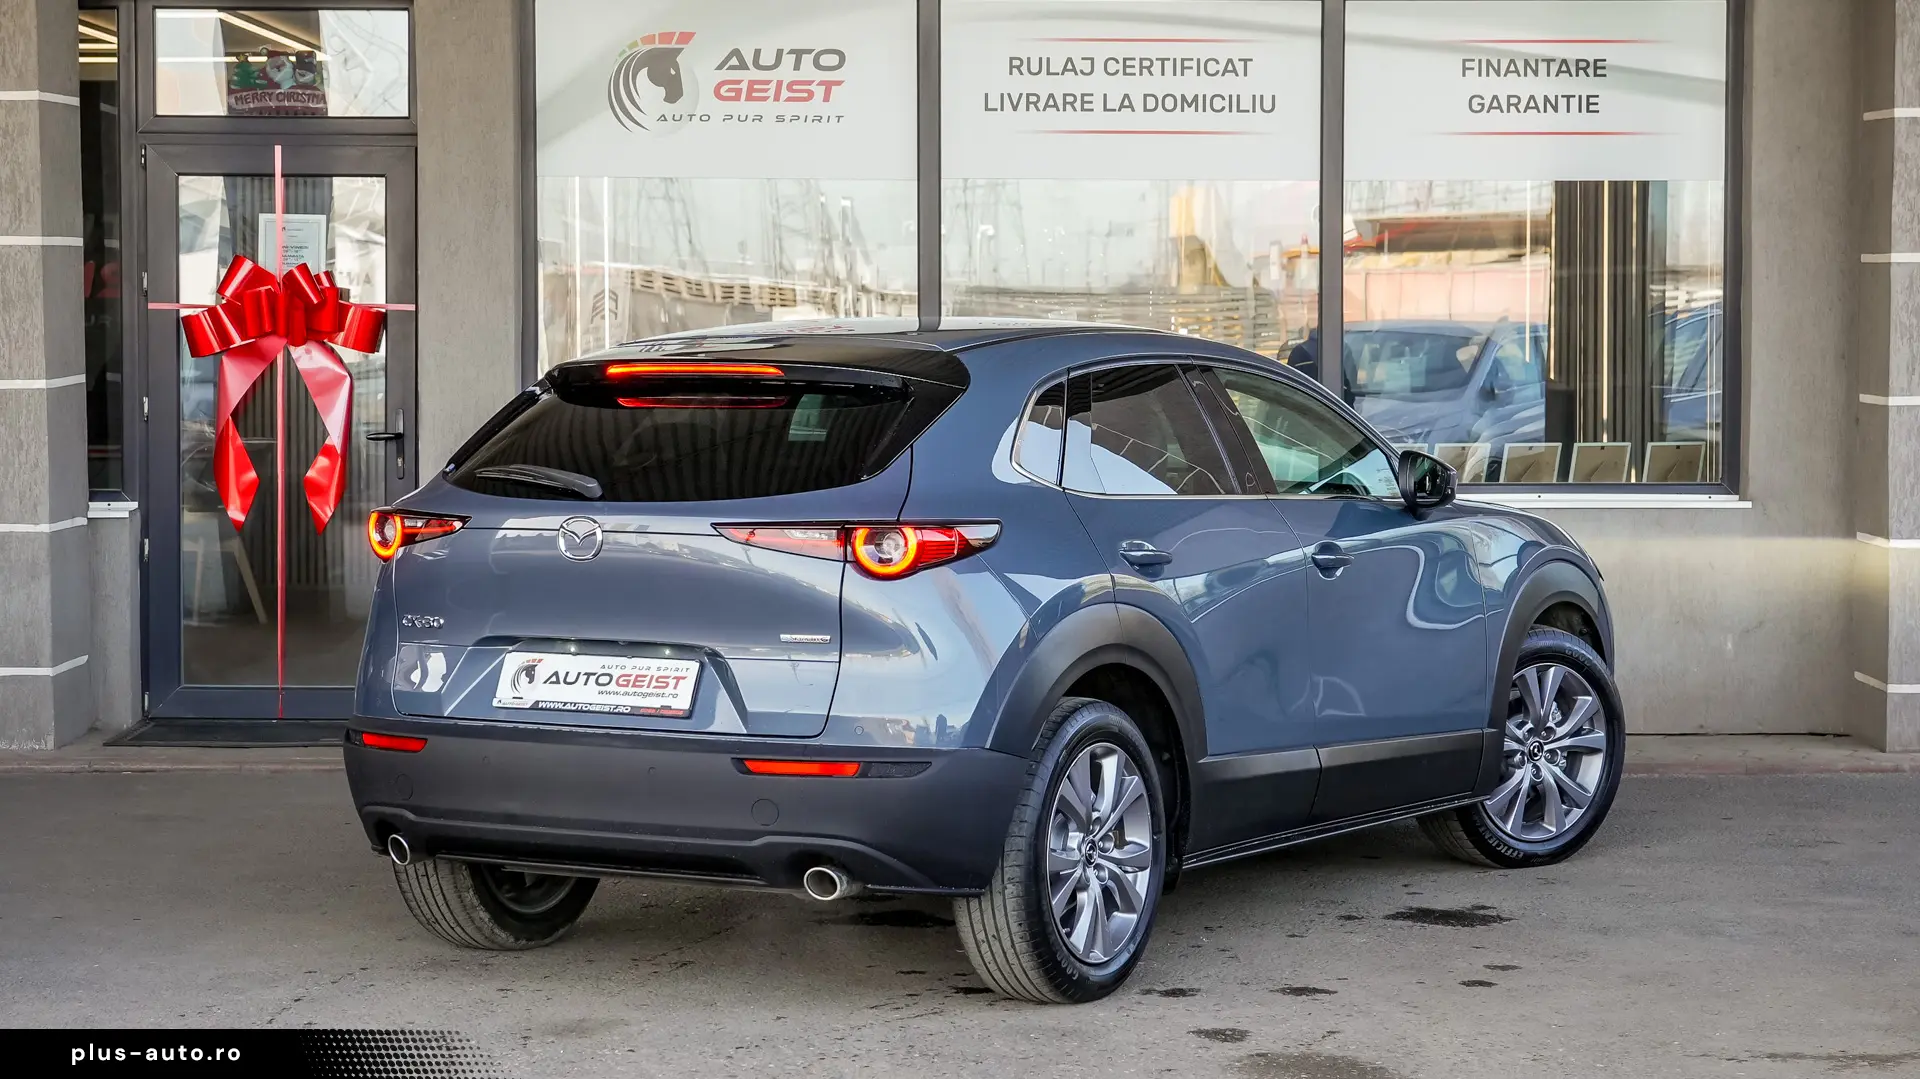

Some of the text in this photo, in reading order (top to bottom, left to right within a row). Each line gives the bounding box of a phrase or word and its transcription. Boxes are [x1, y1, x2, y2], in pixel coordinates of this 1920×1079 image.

[714, 48, 846, 71] AUTO
[1008, 56, 1253, 77] RULAJ CERTIFICAT
[1461, 58, 1607, 77] FINANTARE
[234, 90, 326, 105] MERRY CHRISTMA
[713, 79, 845, 102] GEIST
[984, 92, 1276, 113] LIVRARE LA DOMICILIU
[1468, 94, 1600, 113] GARANTIE
[656, 114, 844, 123] AUTO PUR SPIRIT
[597, 689, 679, 699] www.autogeist.ro
[538, 701, 631, 714] WWW.AUTOGEIST.RO
